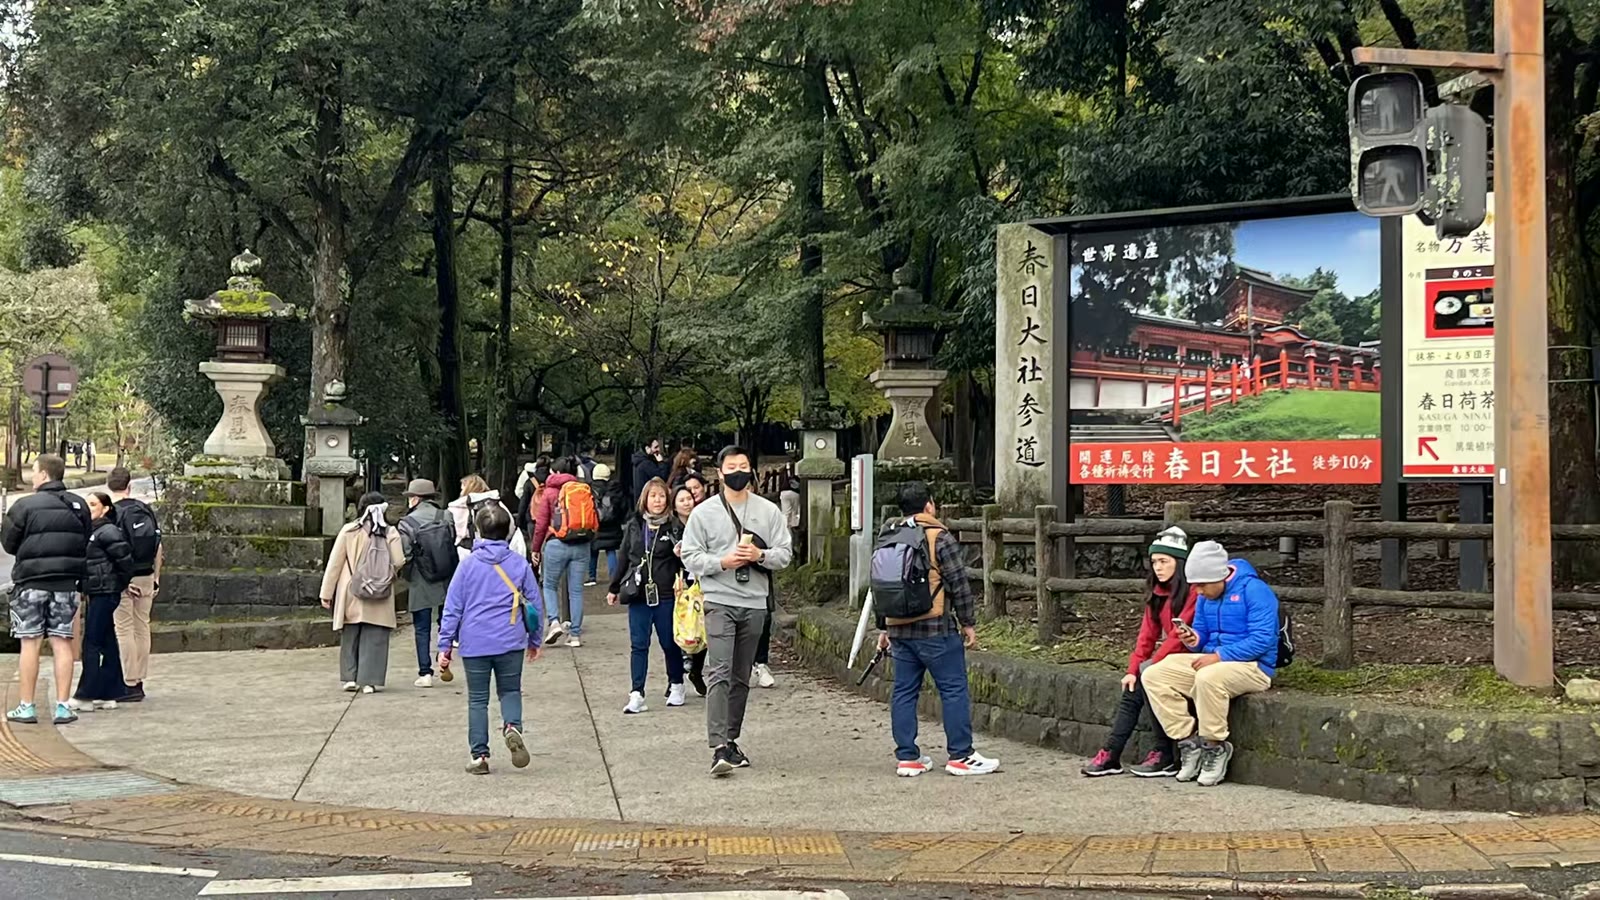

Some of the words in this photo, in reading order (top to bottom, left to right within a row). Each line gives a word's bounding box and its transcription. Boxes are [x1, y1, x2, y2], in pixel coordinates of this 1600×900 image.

[1082, 241, 1159, 262] 世界遺産
[1415, 240, 1440, 253] 名物
[1445, 230, 1491, 254] 万葉
[1016, 240, 1048, 467] 春日大社参道
[1418, 390, 1494, 410] 春日荷茶
[1418, 413, 1457, 421] KASUGA
[1164, 447, 1296, 480] 春日大社
[1312, 454, 1373, 470] 徒歩10分
